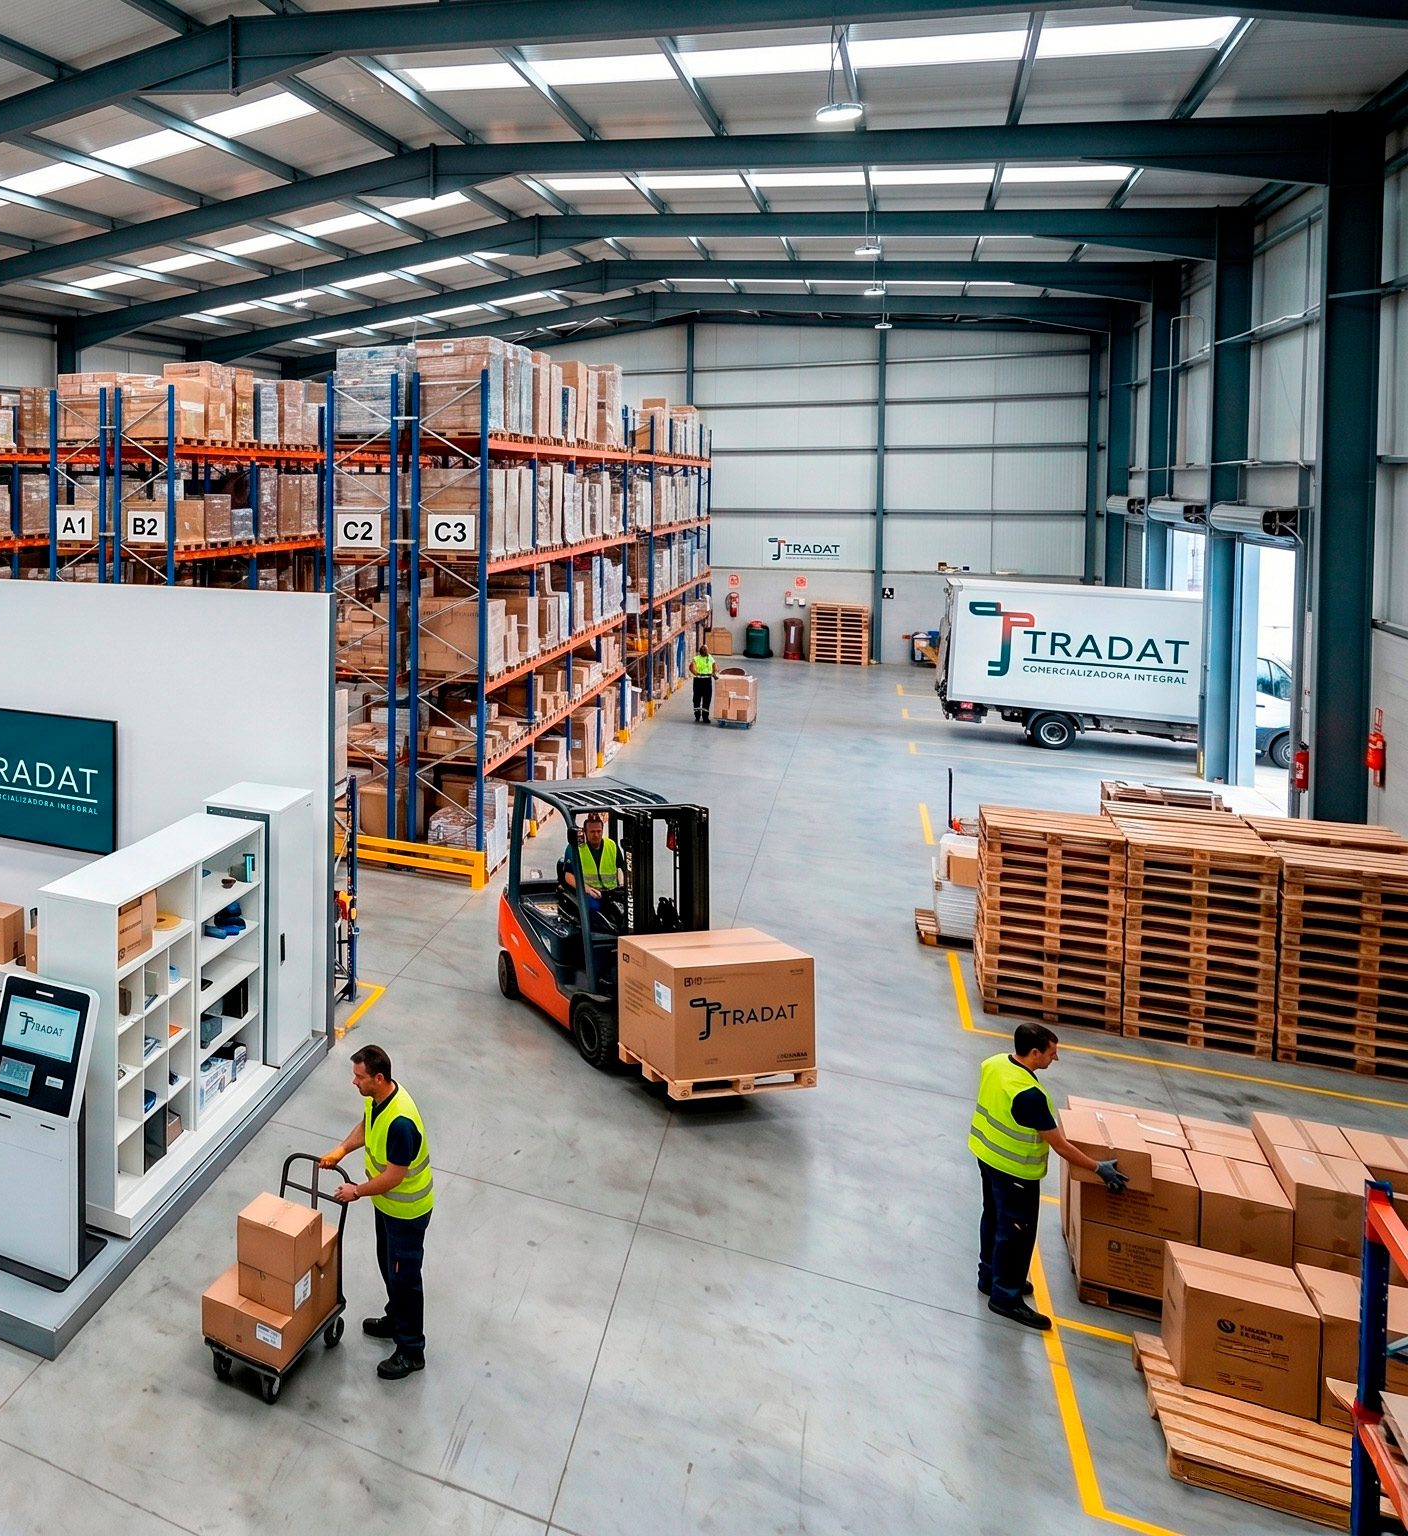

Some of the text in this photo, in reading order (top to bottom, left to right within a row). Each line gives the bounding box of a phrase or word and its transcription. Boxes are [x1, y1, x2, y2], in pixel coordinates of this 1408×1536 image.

[62, 516, 85, 534] A1
[132, 517, 158, 536] B2
[343, 521, 373, 541] C2
[434, 522, 467, 542] C3
[784, 544, 840, 554] TRADAT
[1023, 630, 1190, 665] TRADAT
[1022, 665, 1187, 685] COMERCIALIZADORA INTEGRAL
[719, 1003, 799, 1027] TRADAT
